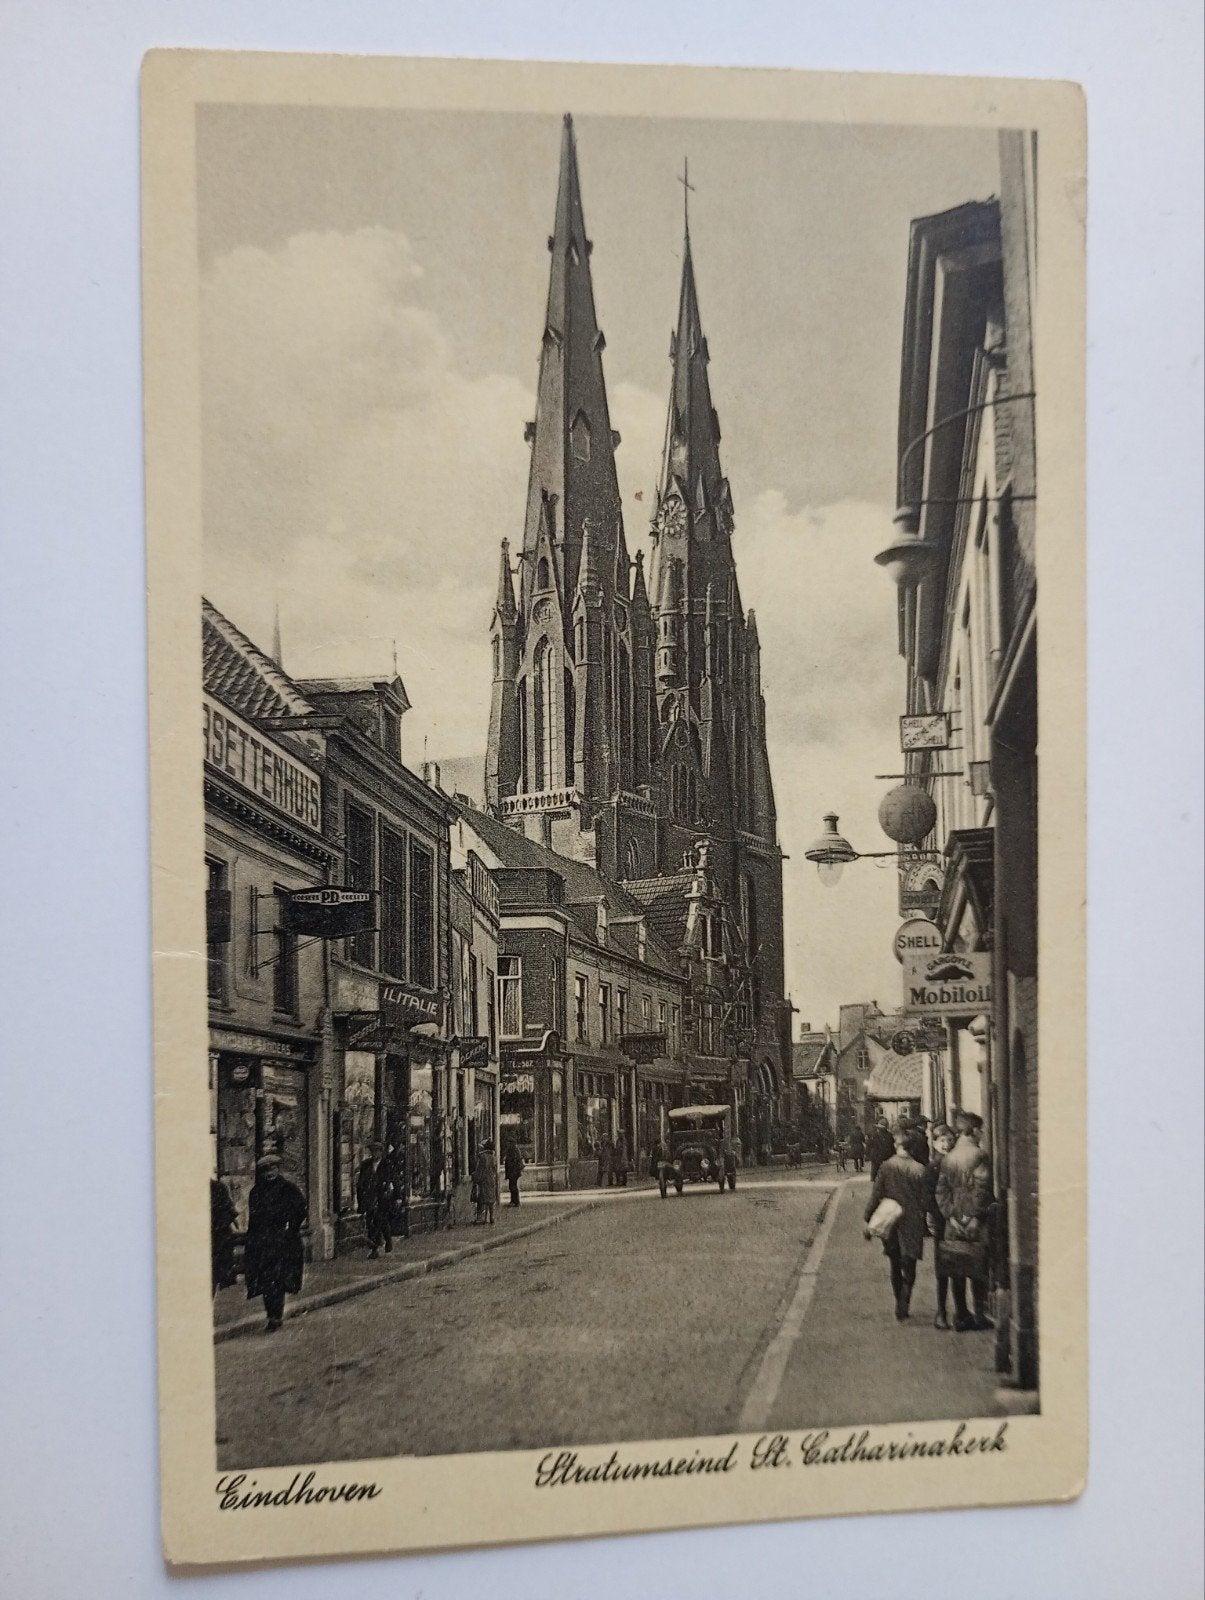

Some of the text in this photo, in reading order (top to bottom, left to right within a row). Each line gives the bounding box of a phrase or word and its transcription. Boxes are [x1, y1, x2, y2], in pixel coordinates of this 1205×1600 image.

[897, 934, 940, 949] SHELL
[926, 955, 974, 971] GARGOYLE
[909, 985, 992, 1006] Mobiloil
[535, 1441, 739, 1488] Stratumseind
[800, 1421, 1009, 1466] Catharinakerk
[215, 1470, 383, 1511] Eindhoven
